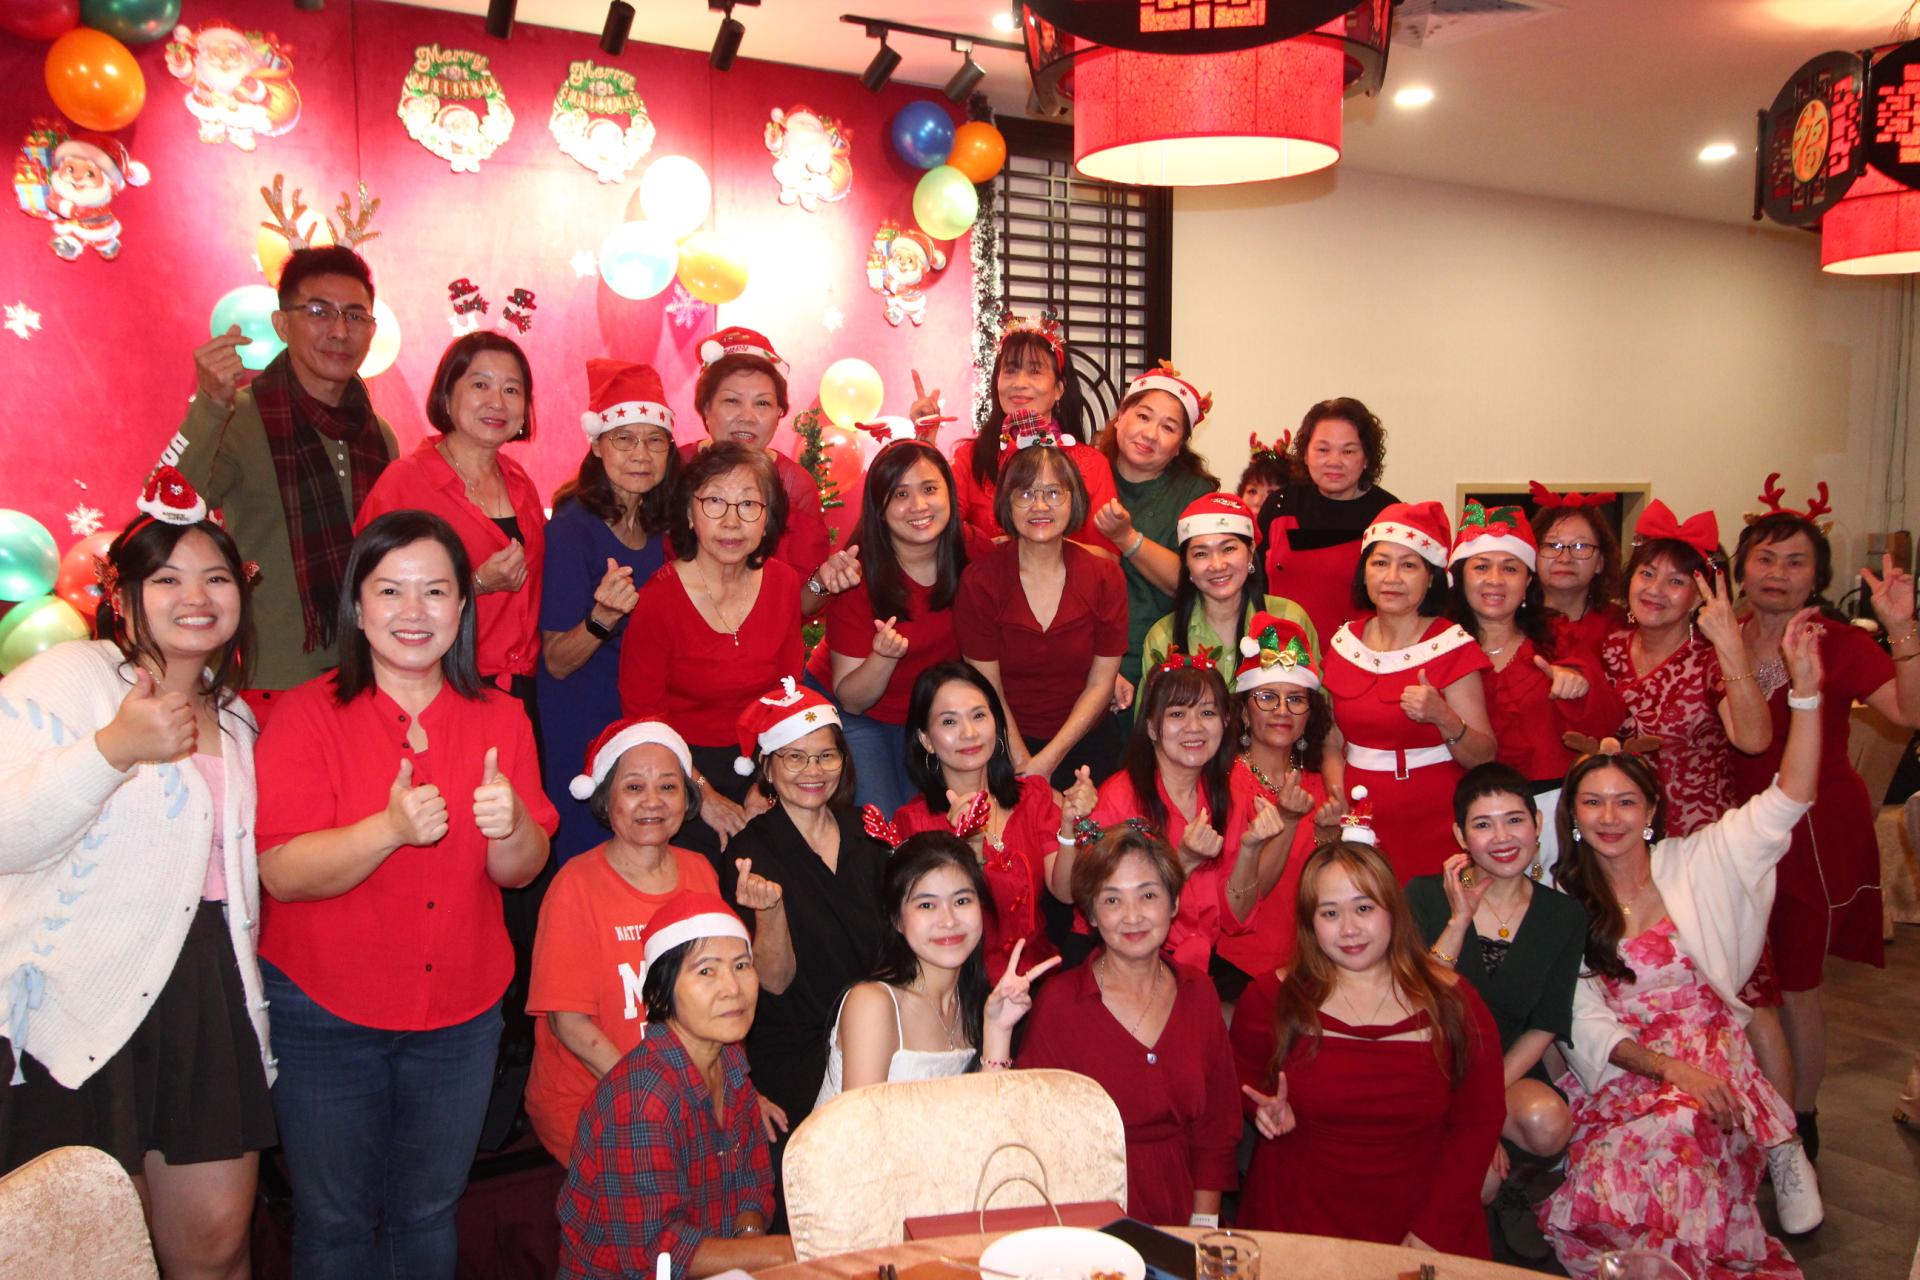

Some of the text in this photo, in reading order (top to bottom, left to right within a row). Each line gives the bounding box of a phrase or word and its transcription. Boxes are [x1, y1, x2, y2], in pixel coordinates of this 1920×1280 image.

[415, 43, 489, 73] Merry
[411, 73, 498, 98] CHRISTMAS
[569, 60, 637, 90] Merry
[1793, 101, 1828, 181] 福
